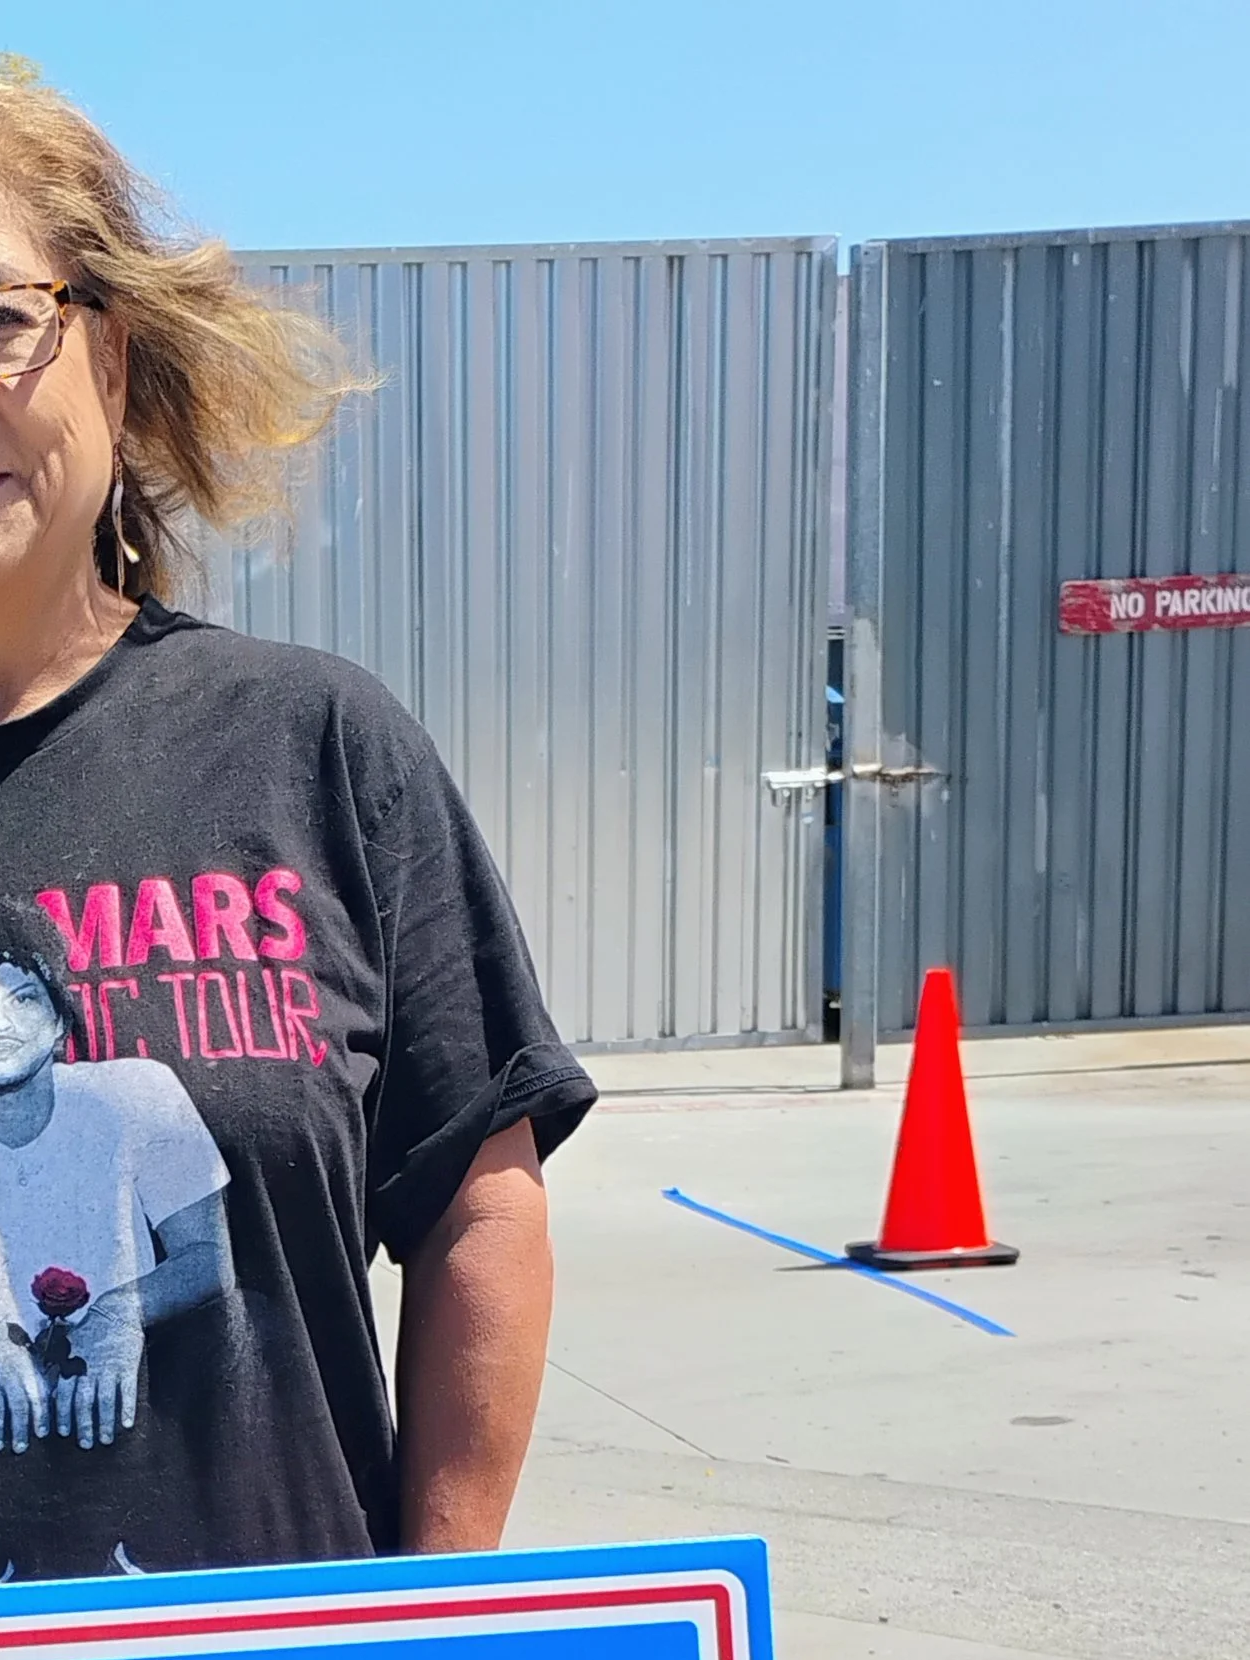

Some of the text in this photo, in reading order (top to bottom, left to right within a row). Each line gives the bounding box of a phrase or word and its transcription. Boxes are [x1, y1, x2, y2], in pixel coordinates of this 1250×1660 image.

[1109, 591, 1146, 620] NO
[35, 867, 307, 972] MARS
[156, 967, 328, 1067] TOUR
